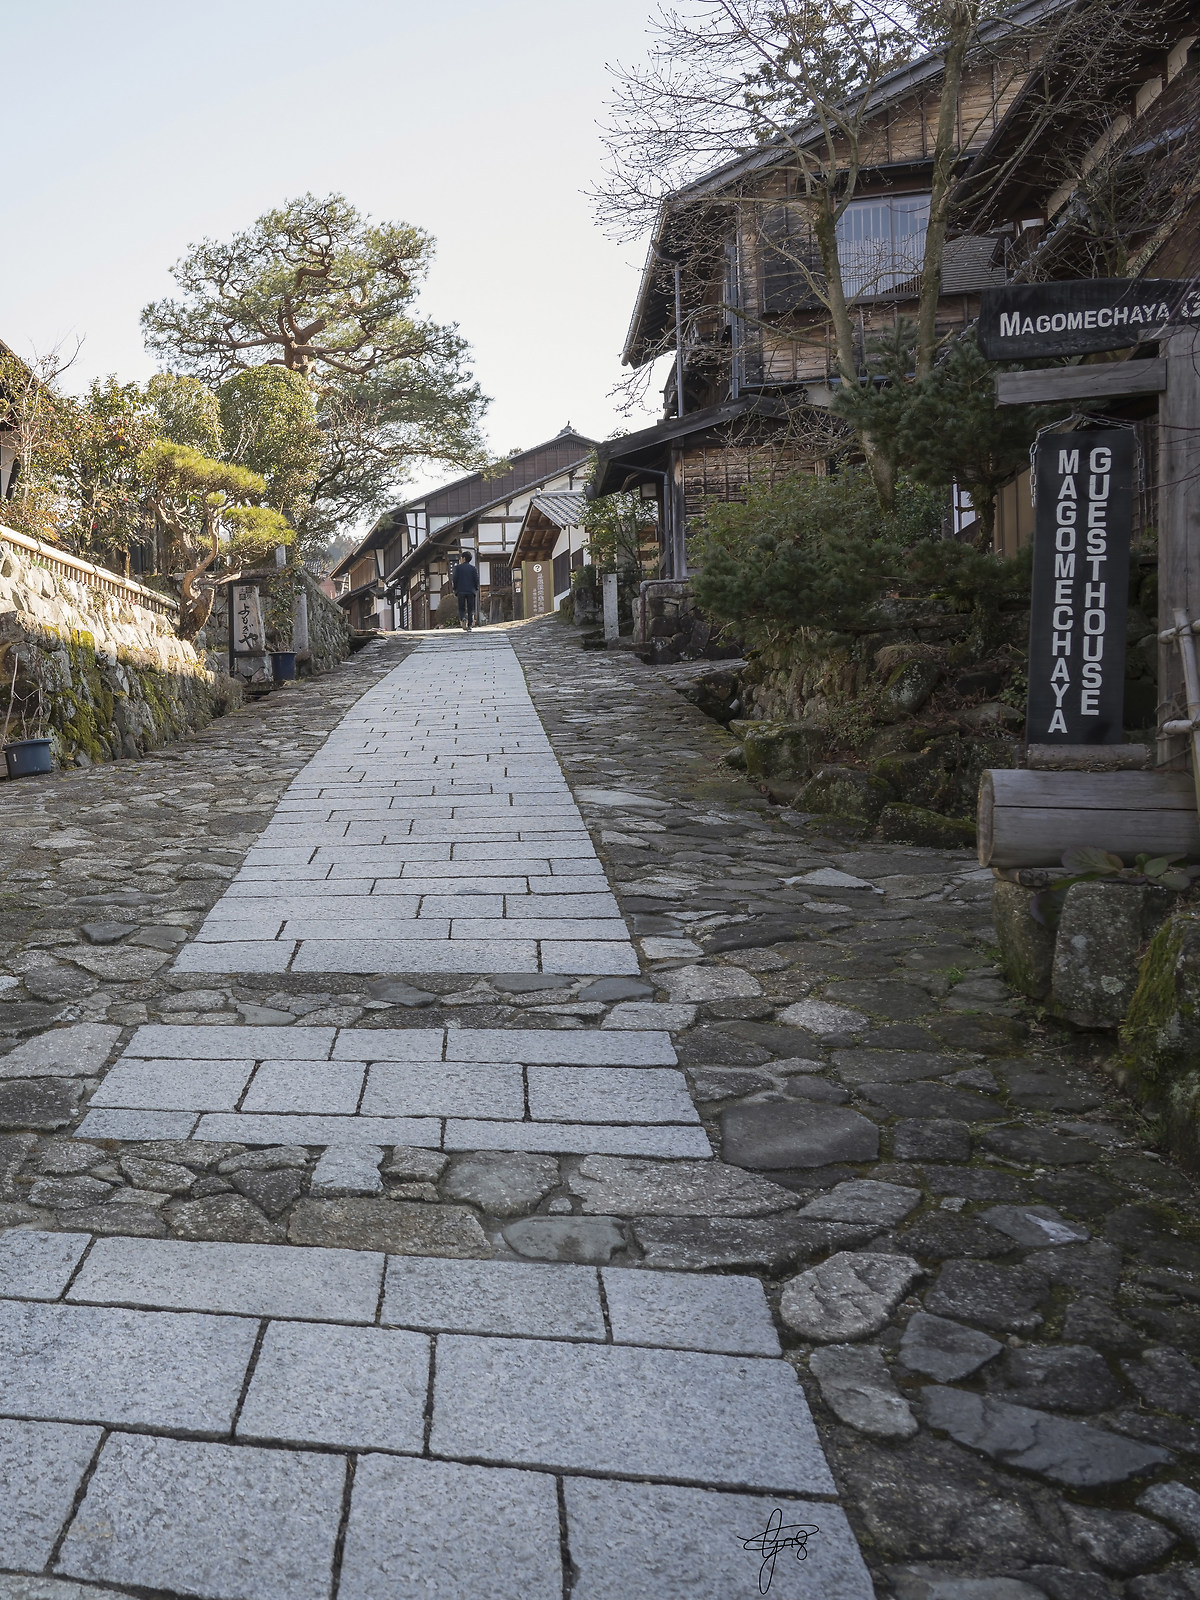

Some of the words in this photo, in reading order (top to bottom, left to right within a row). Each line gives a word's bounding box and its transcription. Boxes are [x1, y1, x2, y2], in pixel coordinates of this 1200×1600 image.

[1000, 302, 1170, 337] MAGOMECHAYA
[1048, 449, 1079, 733] MAGOMECHAYA
[1081, 447, 1112, 715] GUESTHOUSE
